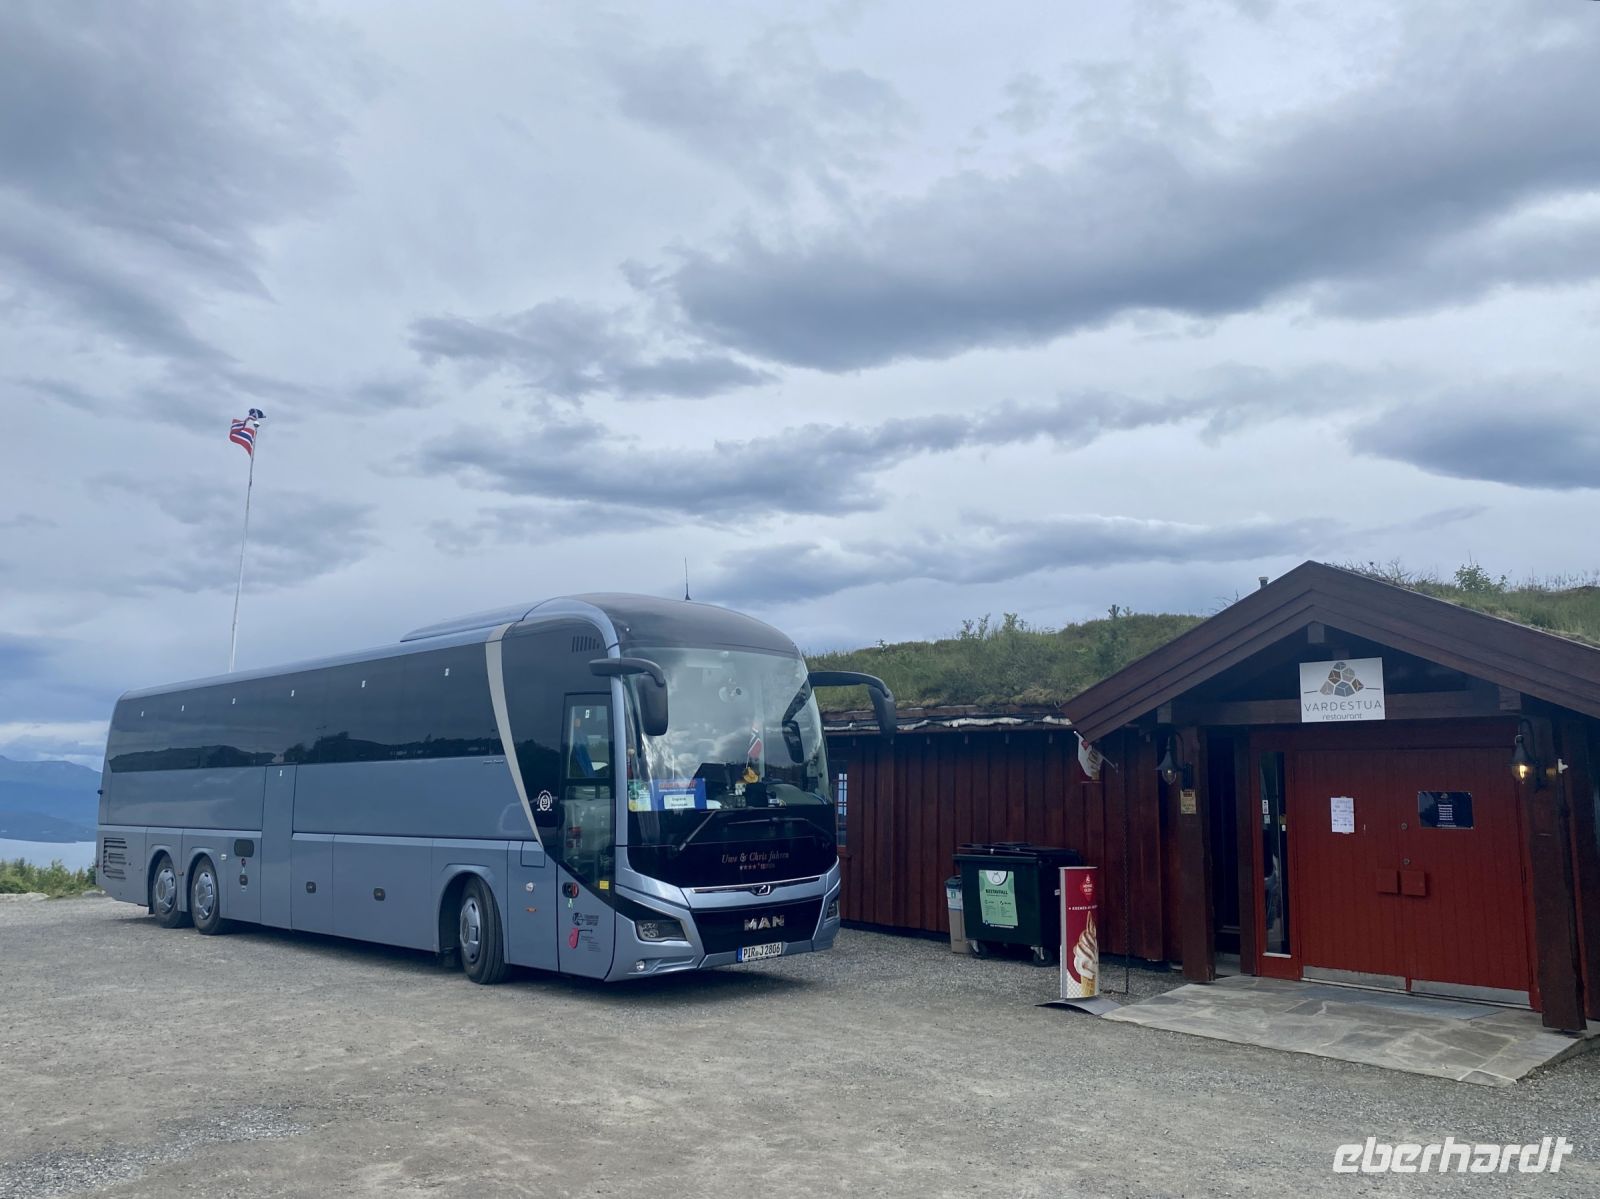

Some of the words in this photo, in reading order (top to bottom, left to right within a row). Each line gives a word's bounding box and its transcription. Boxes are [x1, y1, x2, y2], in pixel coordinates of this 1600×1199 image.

[1303, 700, 1382, 712] VARDESTUA
[1322, 713, 1362, 721] restaurant
[744, 915, 785, 931] MAN
[743, 946, 756, 959] PIR
